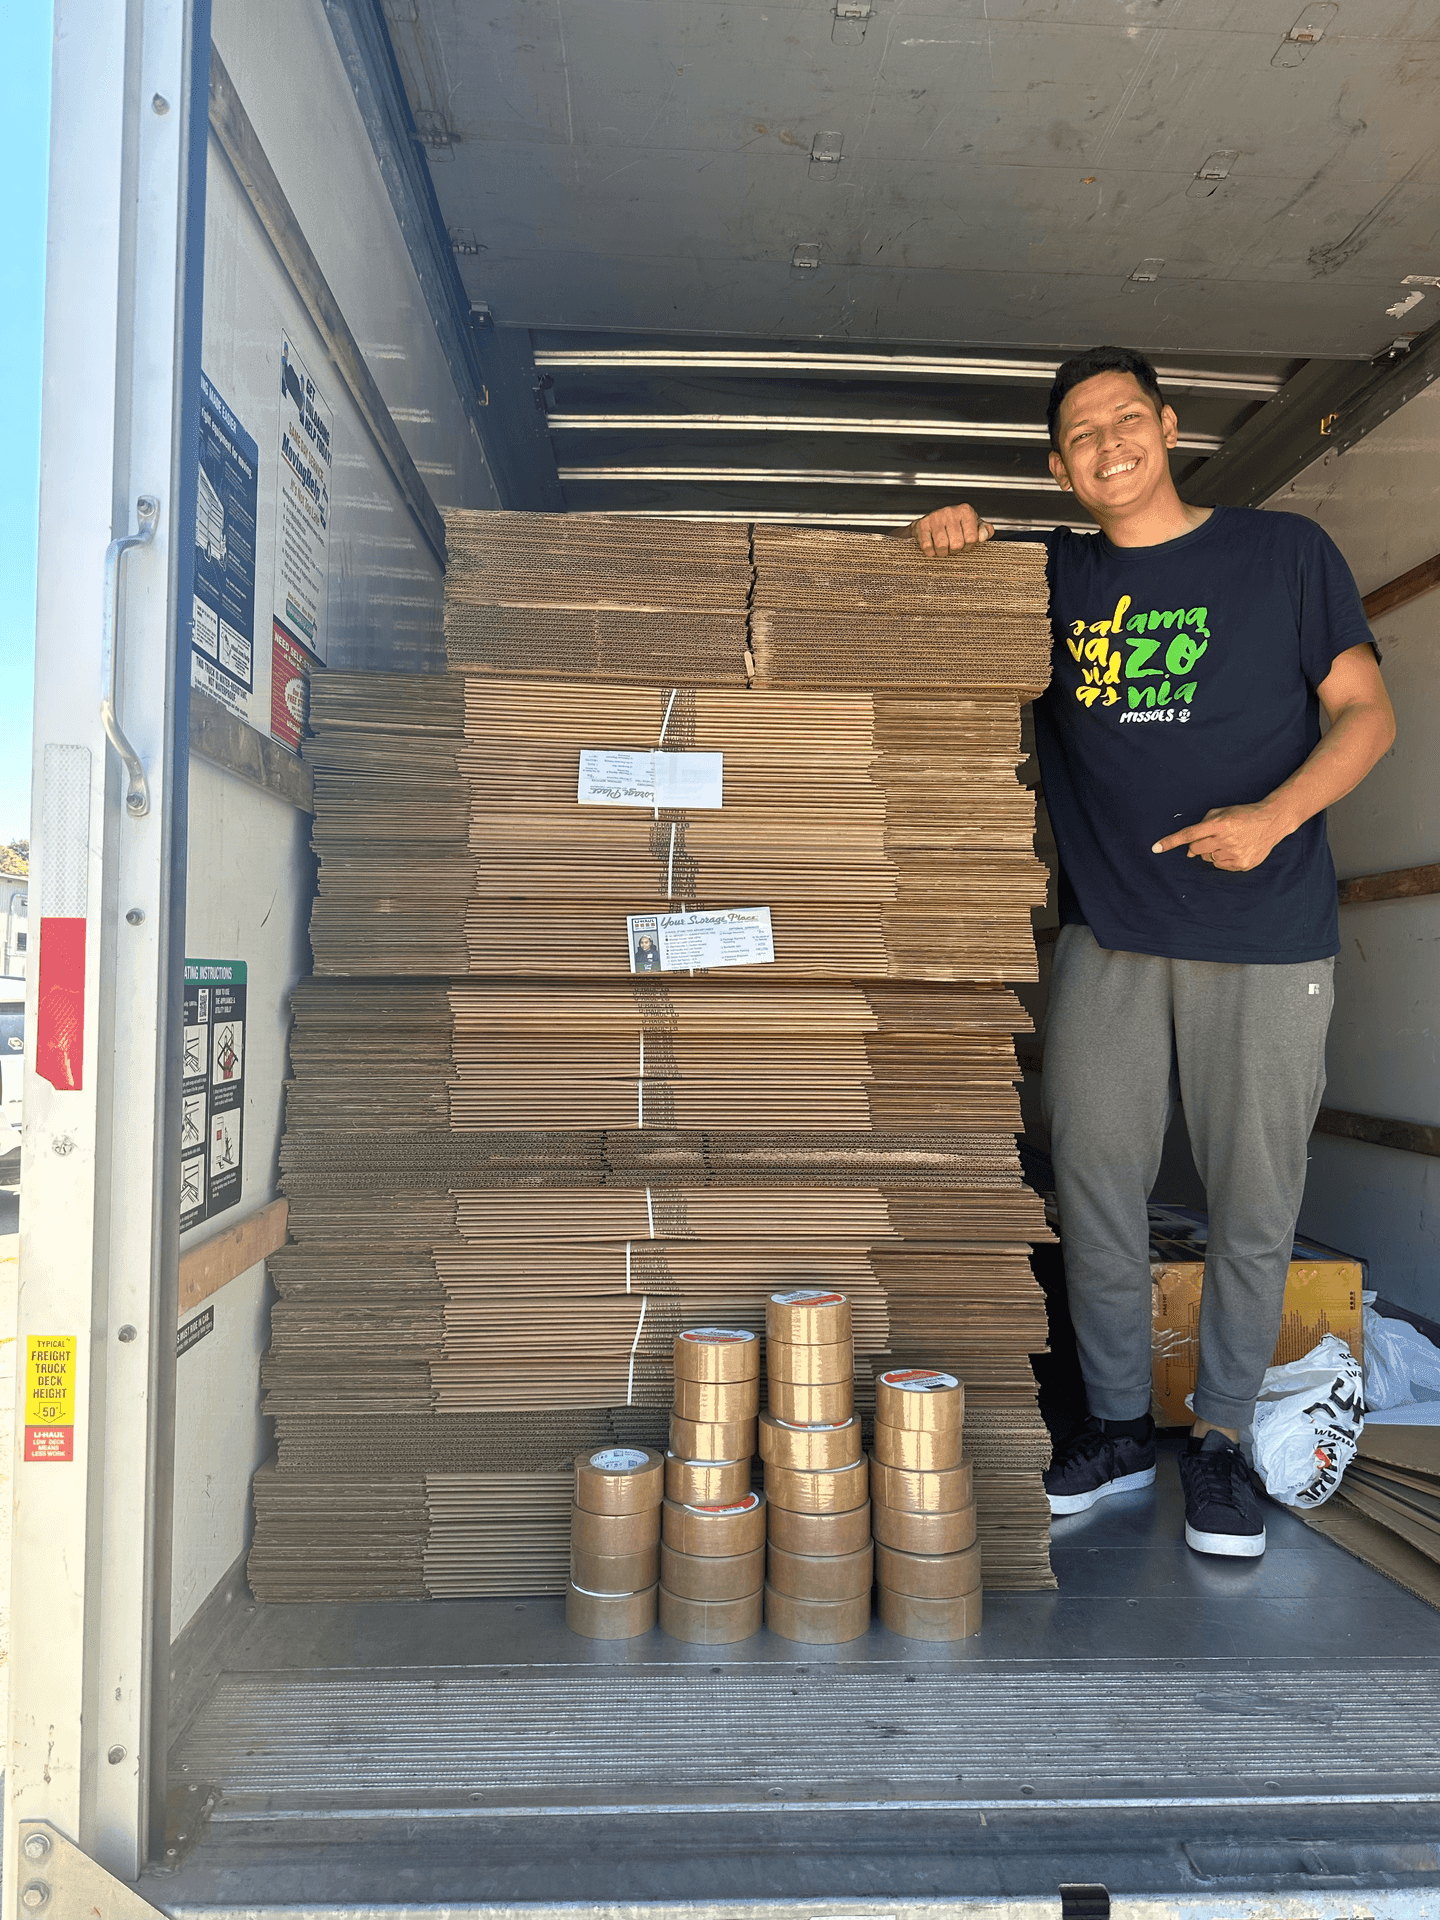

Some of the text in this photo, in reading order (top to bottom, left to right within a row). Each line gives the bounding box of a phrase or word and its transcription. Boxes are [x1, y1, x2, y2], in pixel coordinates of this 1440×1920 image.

[306, 378, 316, 402] GET
[304, 415, 316, 442] HELP
[306, 396, 331, 447] UNLOADING
[275, 632, 290, 652] NEED
[204, 661, 215, 678] TRUCK
[661, 913, 758, 929] Your Storage Place
[199, 966, 233, 980] INSTRUCTIONS
[37, 1340, 65, 1348] TYPICAL
[31, 1350, 71, 1361] FREIGHT
[35, 1363, 66, 1373] TRUCK
[38, 1375, 63, 1386] DECK
[33, 1388, 67, 1398] HEIGHT
